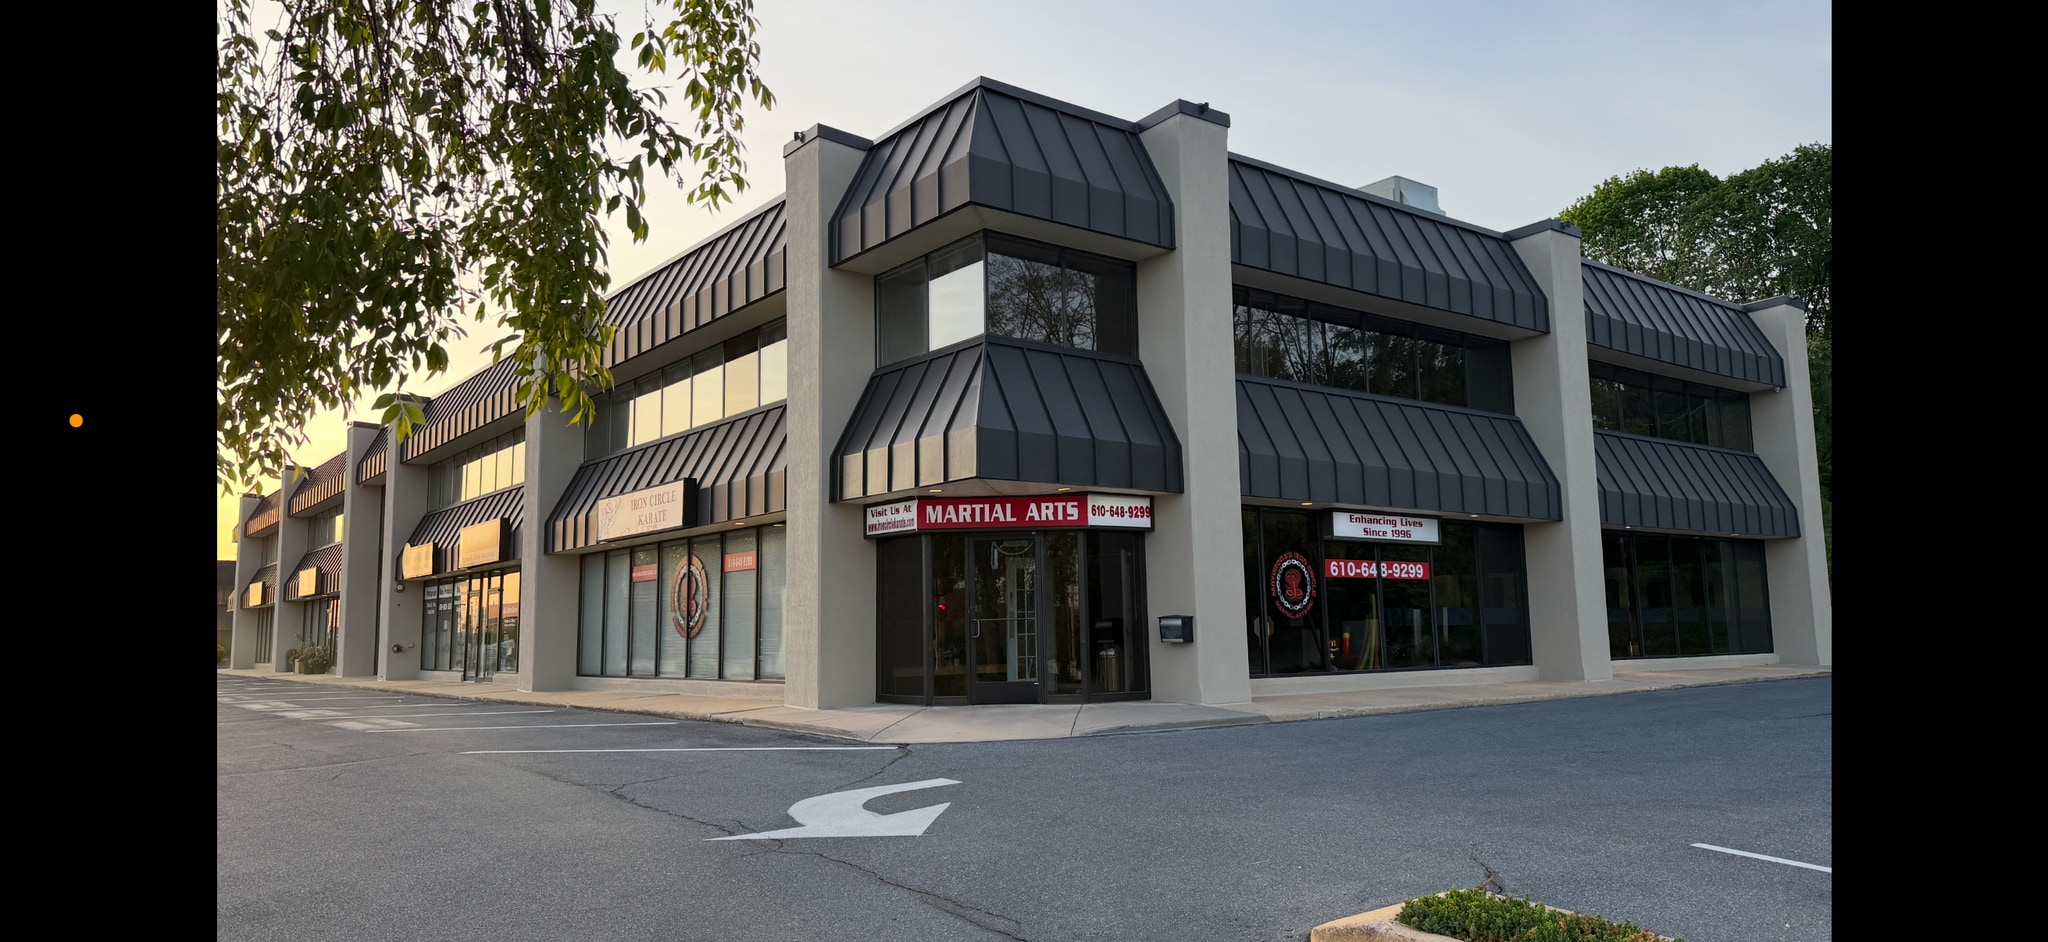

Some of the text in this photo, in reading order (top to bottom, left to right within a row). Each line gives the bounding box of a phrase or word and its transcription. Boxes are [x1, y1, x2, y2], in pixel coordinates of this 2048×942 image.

[630, 490, 677, 511] IRON CIRCLE
[638, 509, 668, 526] KARATE
[870, 504, 912, 518] Visit Us At
[925, 501, 1079, 524] MARTIAL ARTS
[1091, 504, 1152, 519] 610-648-9299
[1349, 514, 1423, 528] Enhancing Lives
[1363, 528, 1412, 539] Since 1996
[1330, 561, 1424, 579] 610-648-9299
